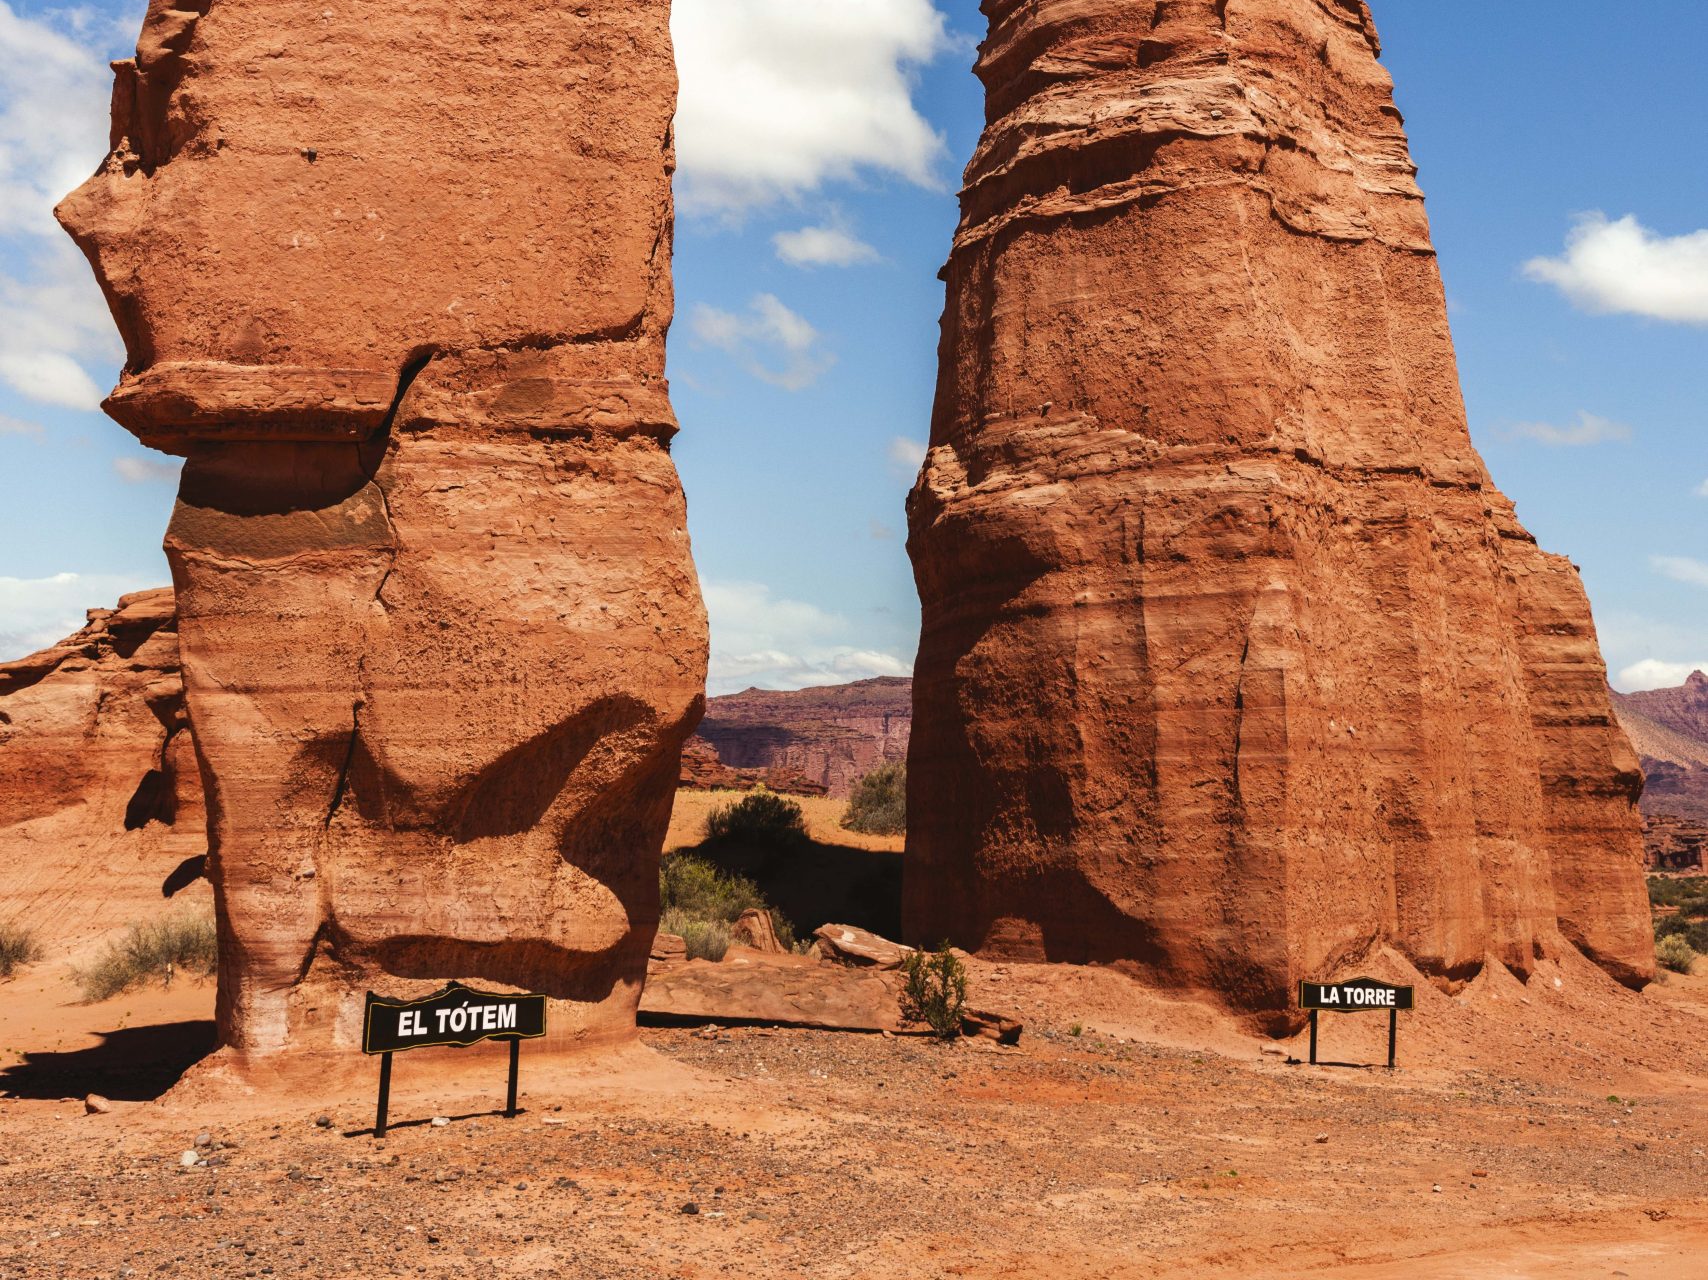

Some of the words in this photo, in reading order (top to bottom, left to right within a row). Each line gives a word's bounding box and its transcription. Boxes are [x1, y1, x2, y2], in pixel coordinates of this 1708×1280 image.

[1320, 986, 1340, 1004] LA
[1343, 987, 1396, 1006] TORRE
[398, 1010, 428, 1037] EL
[435, 1001, 517, 1034] TÓTEM
